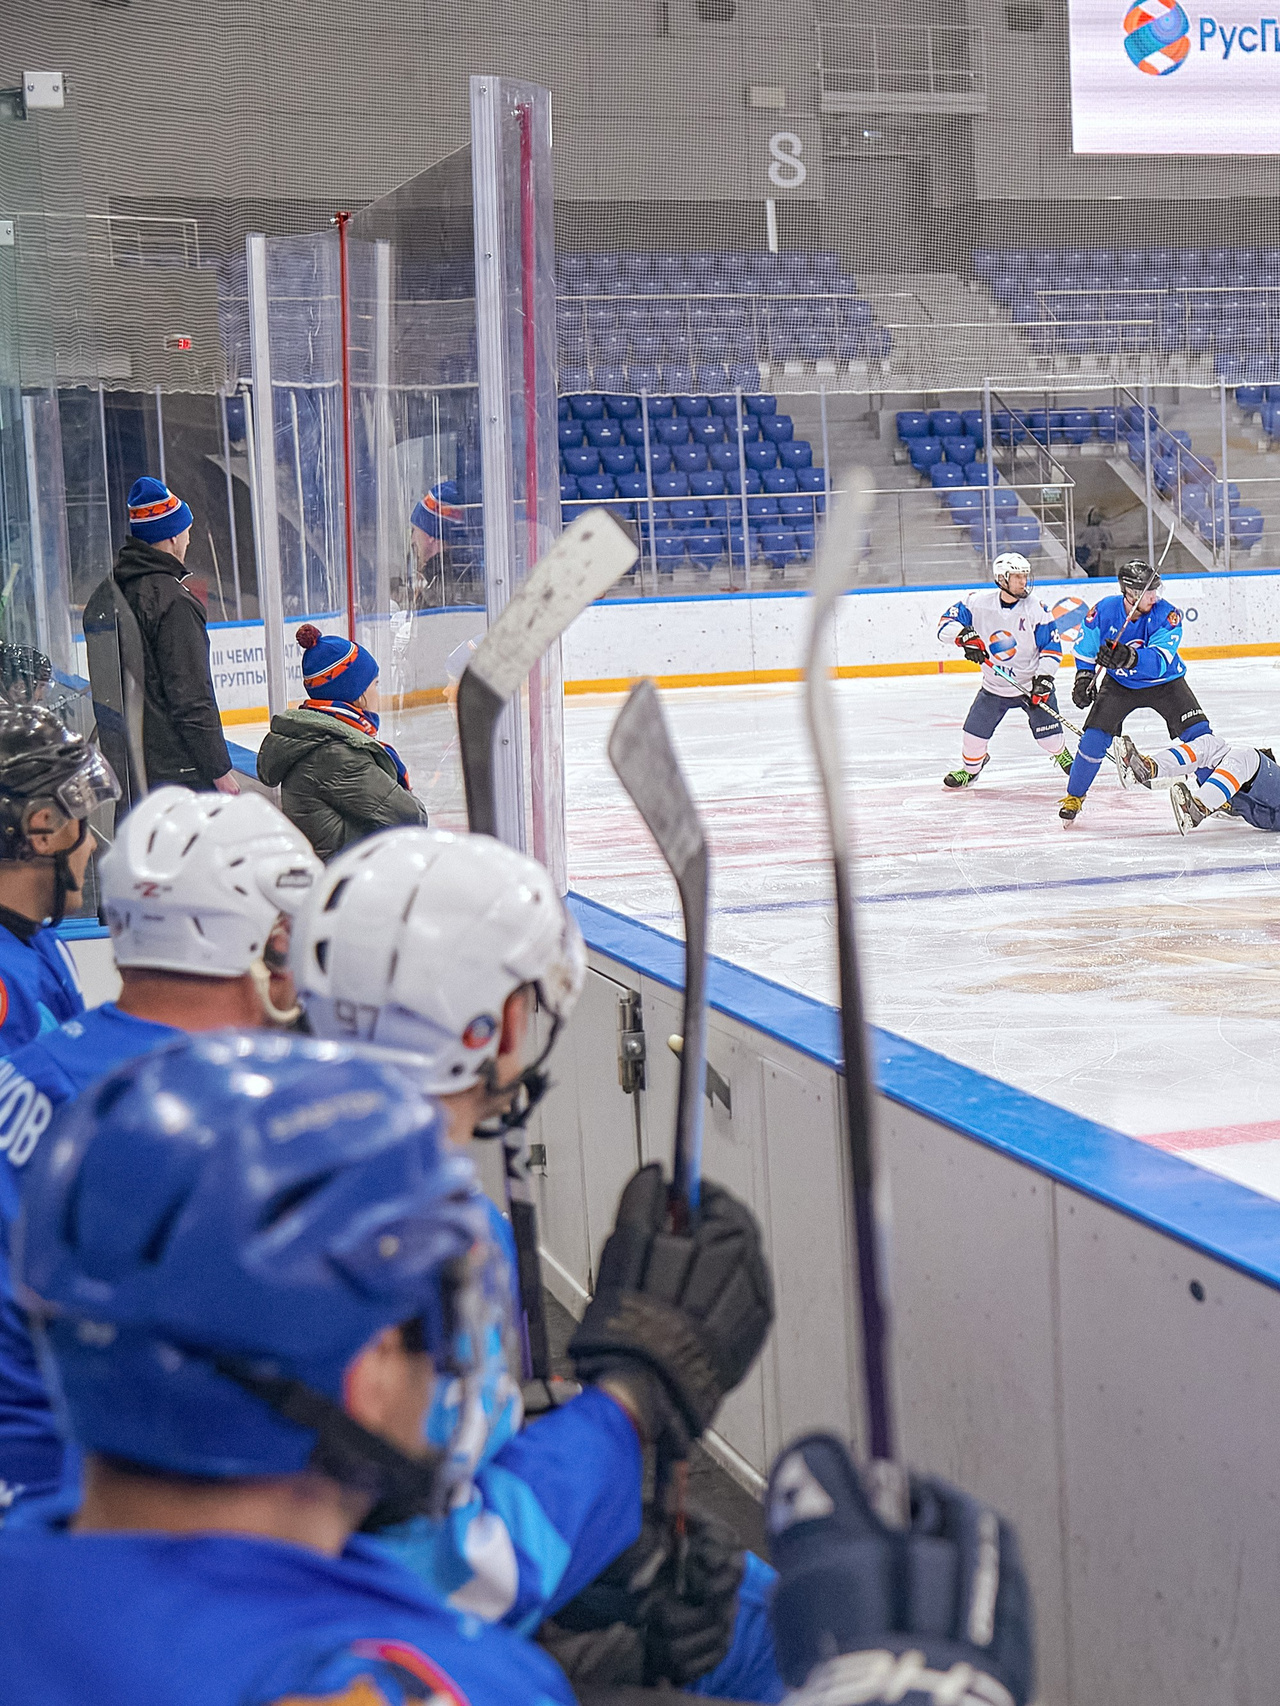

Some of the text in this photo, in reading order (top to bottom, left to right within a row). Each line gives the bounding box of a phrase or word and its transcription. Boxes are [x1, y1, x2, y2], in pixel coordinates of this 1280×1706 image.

[768, 131, 807, 188] 8
[214, 669, 267, 689] ГРУППЫ
[334, 998, 380, 1041] 97
